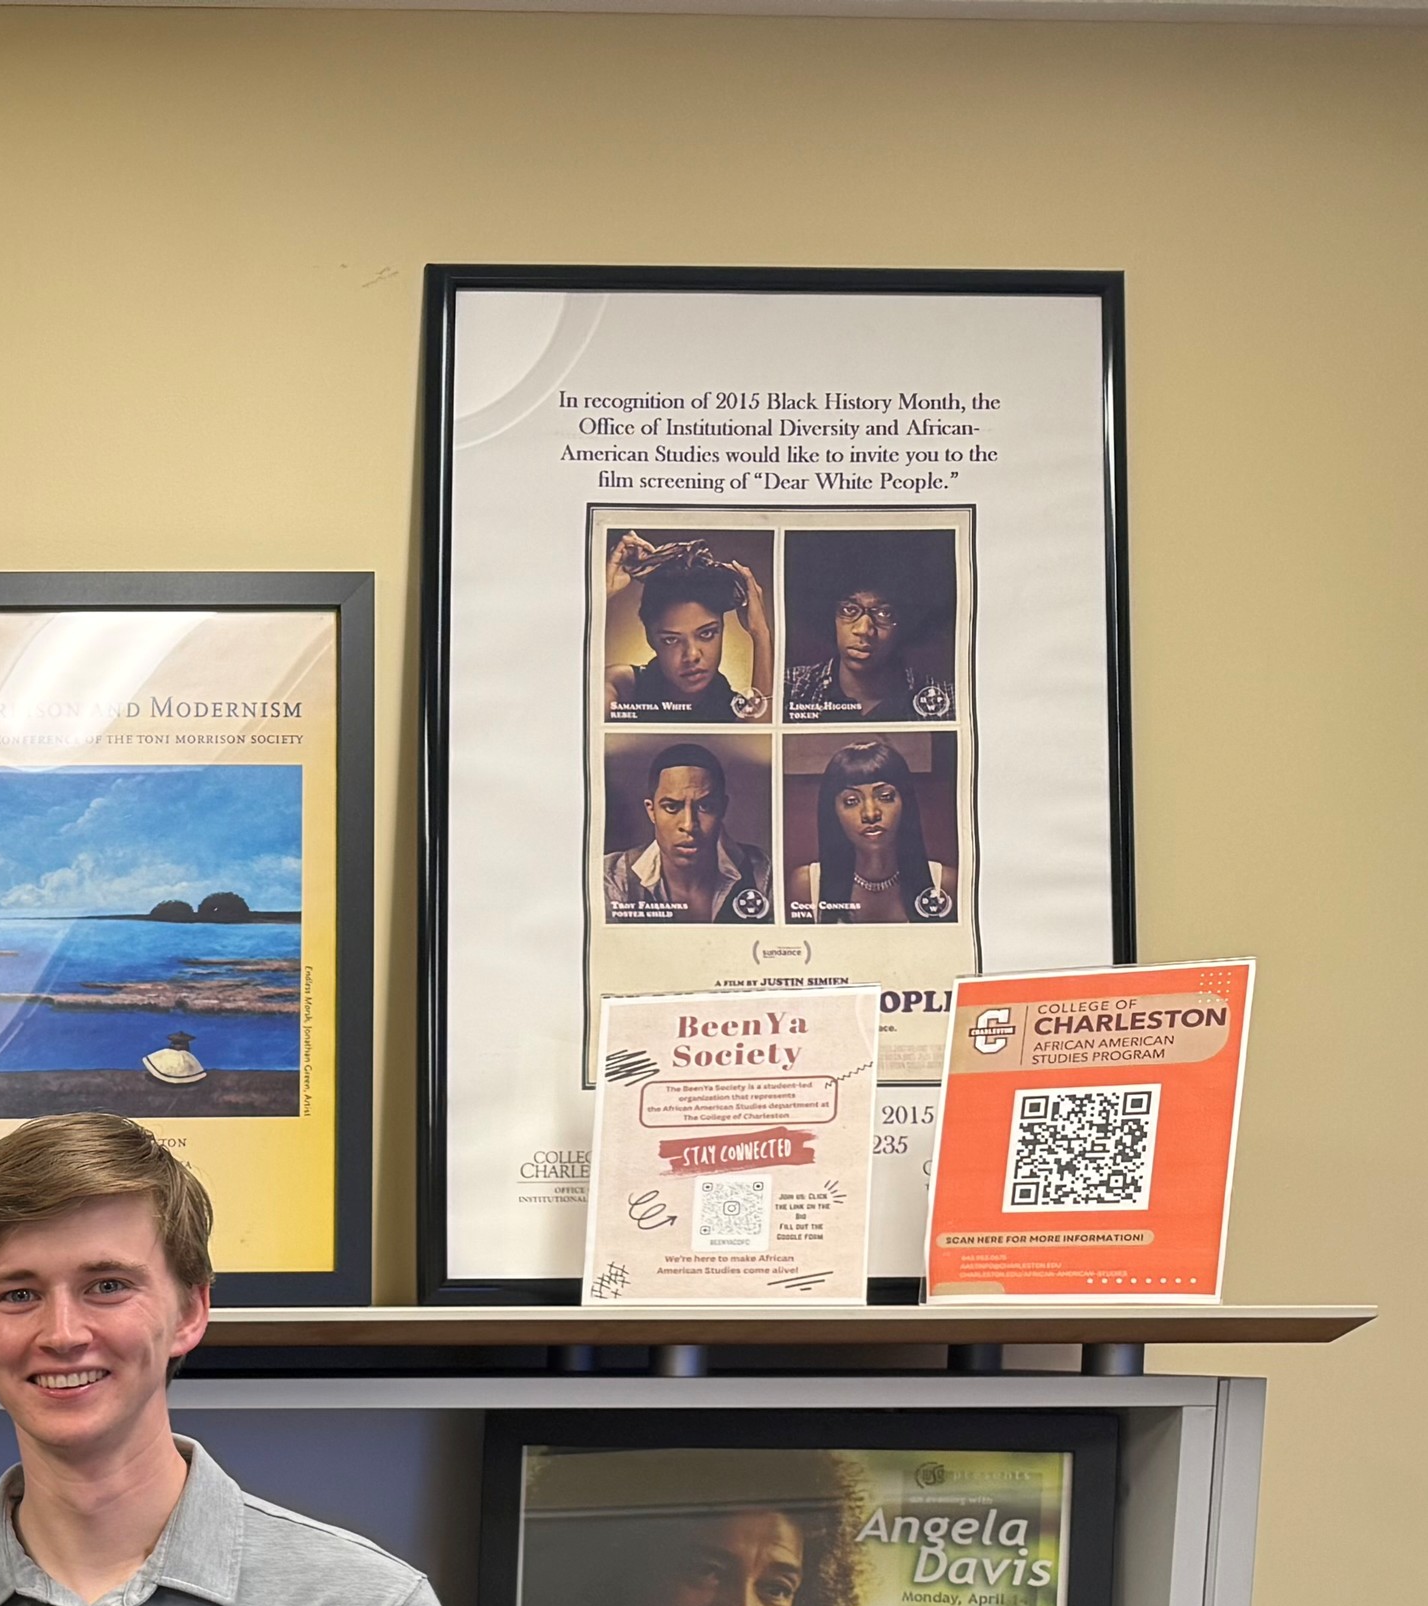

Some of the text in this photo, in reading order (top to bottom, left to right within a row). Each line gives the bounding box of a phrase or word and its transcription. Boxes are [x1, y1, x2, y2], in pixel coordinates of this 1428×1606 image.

[560, 391, 1000, 414] In recognition of 2015 Black History Month, the
[579, 417, 979, 439] Office of Institutional Diversity and African-
[560, 444, 997, 466] American Studies would like to invite you to the
[599, 470, 958, 493] film screening of “Dear White People.”
[1038, 999, 1139, 1014] COLLEGE OF
[678, 1011, 807, 1037] BeenYa
[1034, 1007, 1226, 1035] CHARLESTON
[1033, 1035, 1174, 1051] AFRICAN AMERICAN
[672, 1041, 800, 1070] Society
[1032, 1049, 1164, 1064] STUDIES PROGRAM
[683, 1144, 715, 1166] STAY
[720, 1138, 790, 1162] CONNECTED
[854, 1508, 1028, 1547] Angela
[913, 1546, 1052, 1587] Davis
[902, 1591, 1004, 1606] Monday, April
